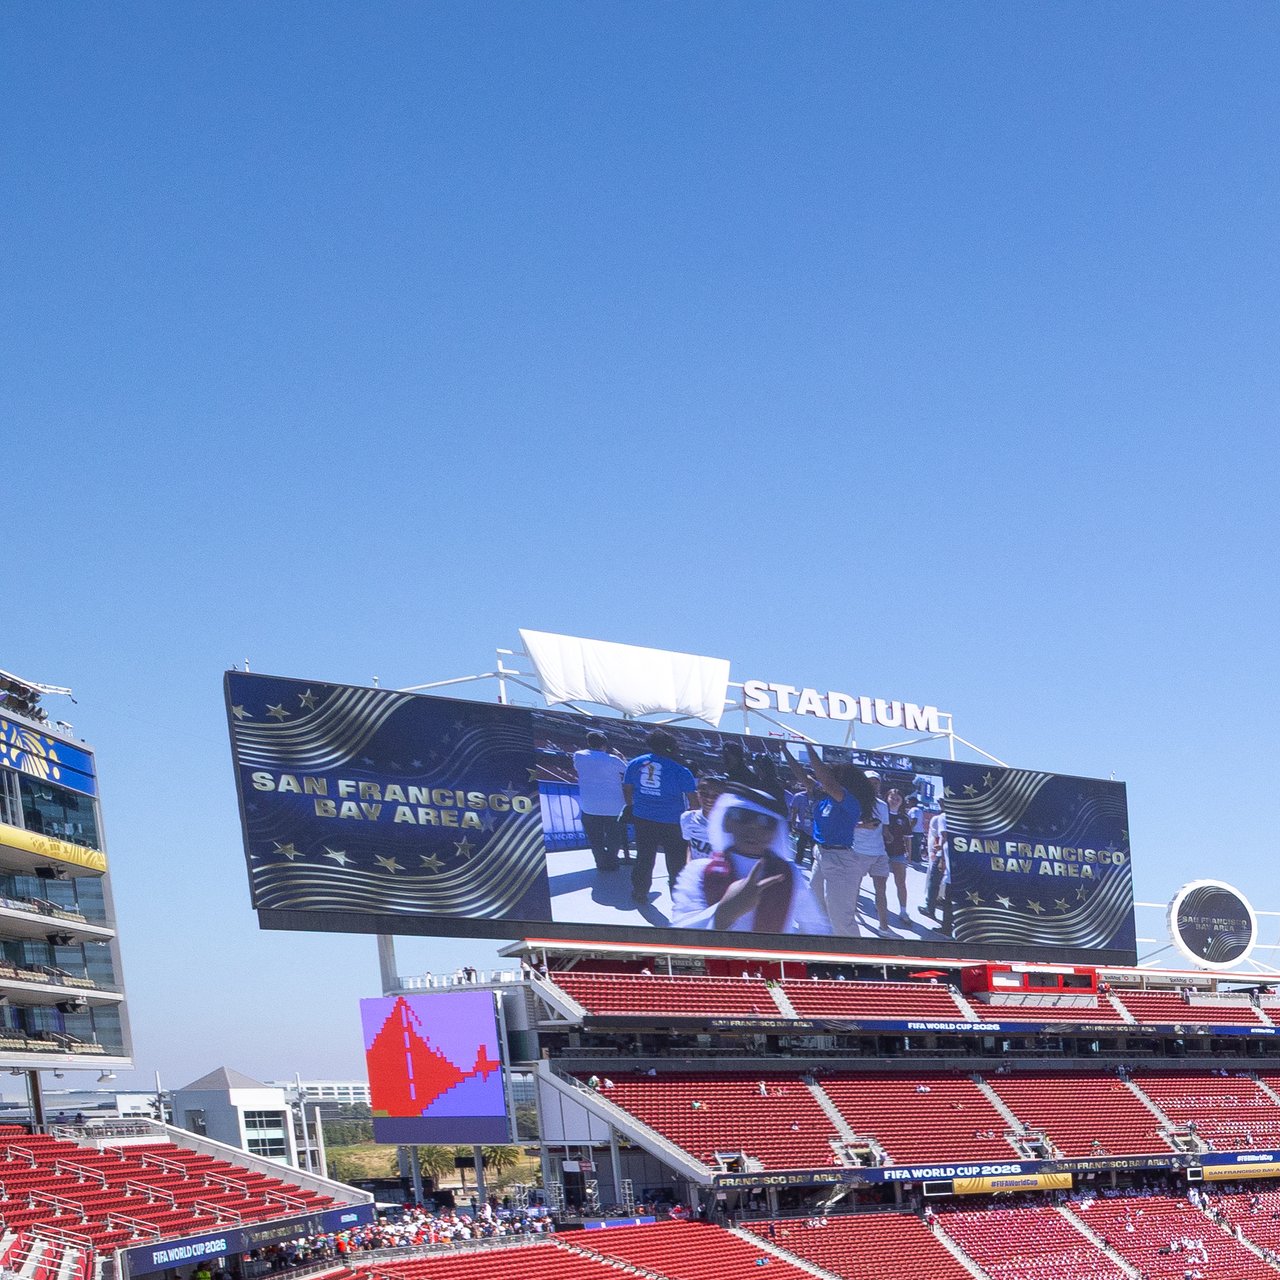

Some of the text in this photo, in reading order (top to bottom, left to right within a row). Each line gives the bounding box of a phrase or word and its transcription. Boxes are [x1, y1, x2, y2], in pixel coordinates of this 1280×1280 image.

[744, 680, 939, 733] STADIUM
[252, 772, 532, 814] SAN FRANCISCO
[315, 799, 483, 829] BAY AREA
[953, 837, 1125, 866] SAN FRANCISCO
[991, 856, 1094, 879] BAY AREA
[973, 1023, 1000, 1031] 2026
[720, 1172, 843, 1187] FRANCISCO BAY AREA
[884, 1163, 1021, 1180] FIFA WORLD CUP 2026
[1225, 1168, 1261, 1176] FRANCISCO
[991, 1179, 1038, 1188] #FIFAWorldCup
[153, 1237, 227, 1265] FIFA WORLD CUP 2026
